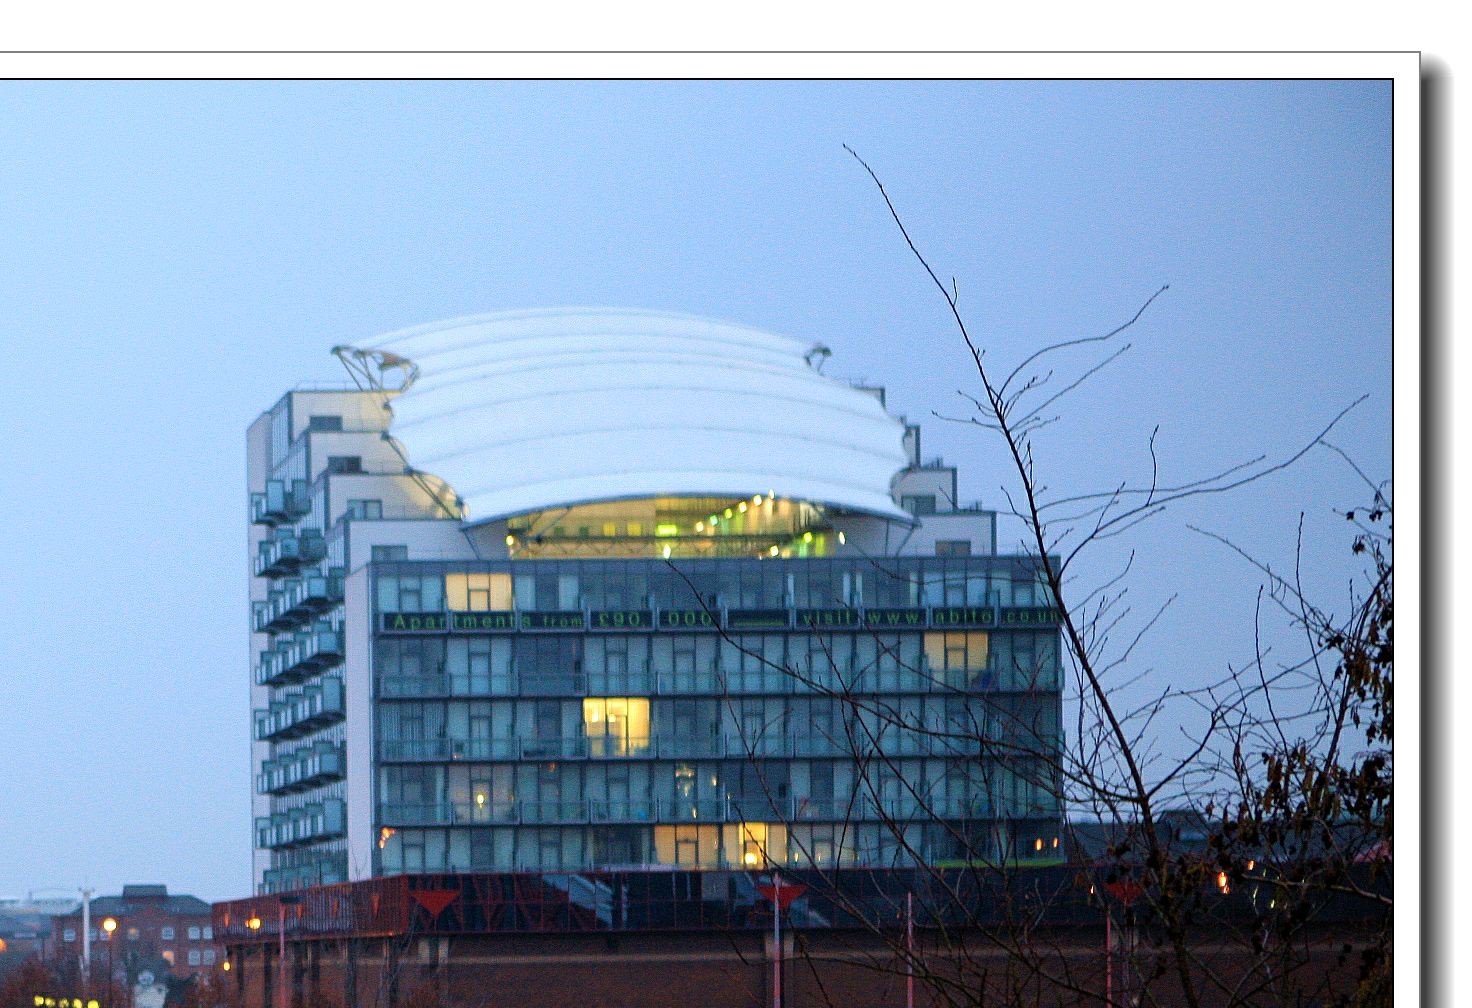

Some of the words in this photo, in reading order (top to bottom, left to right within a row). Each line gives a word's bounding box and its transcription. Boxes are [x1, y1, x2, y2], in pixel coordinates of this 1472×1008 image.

[394, 614, 531, 630] Apartments
[543, 614, 583, 627] from
[803, 611, 852, 625] visit
